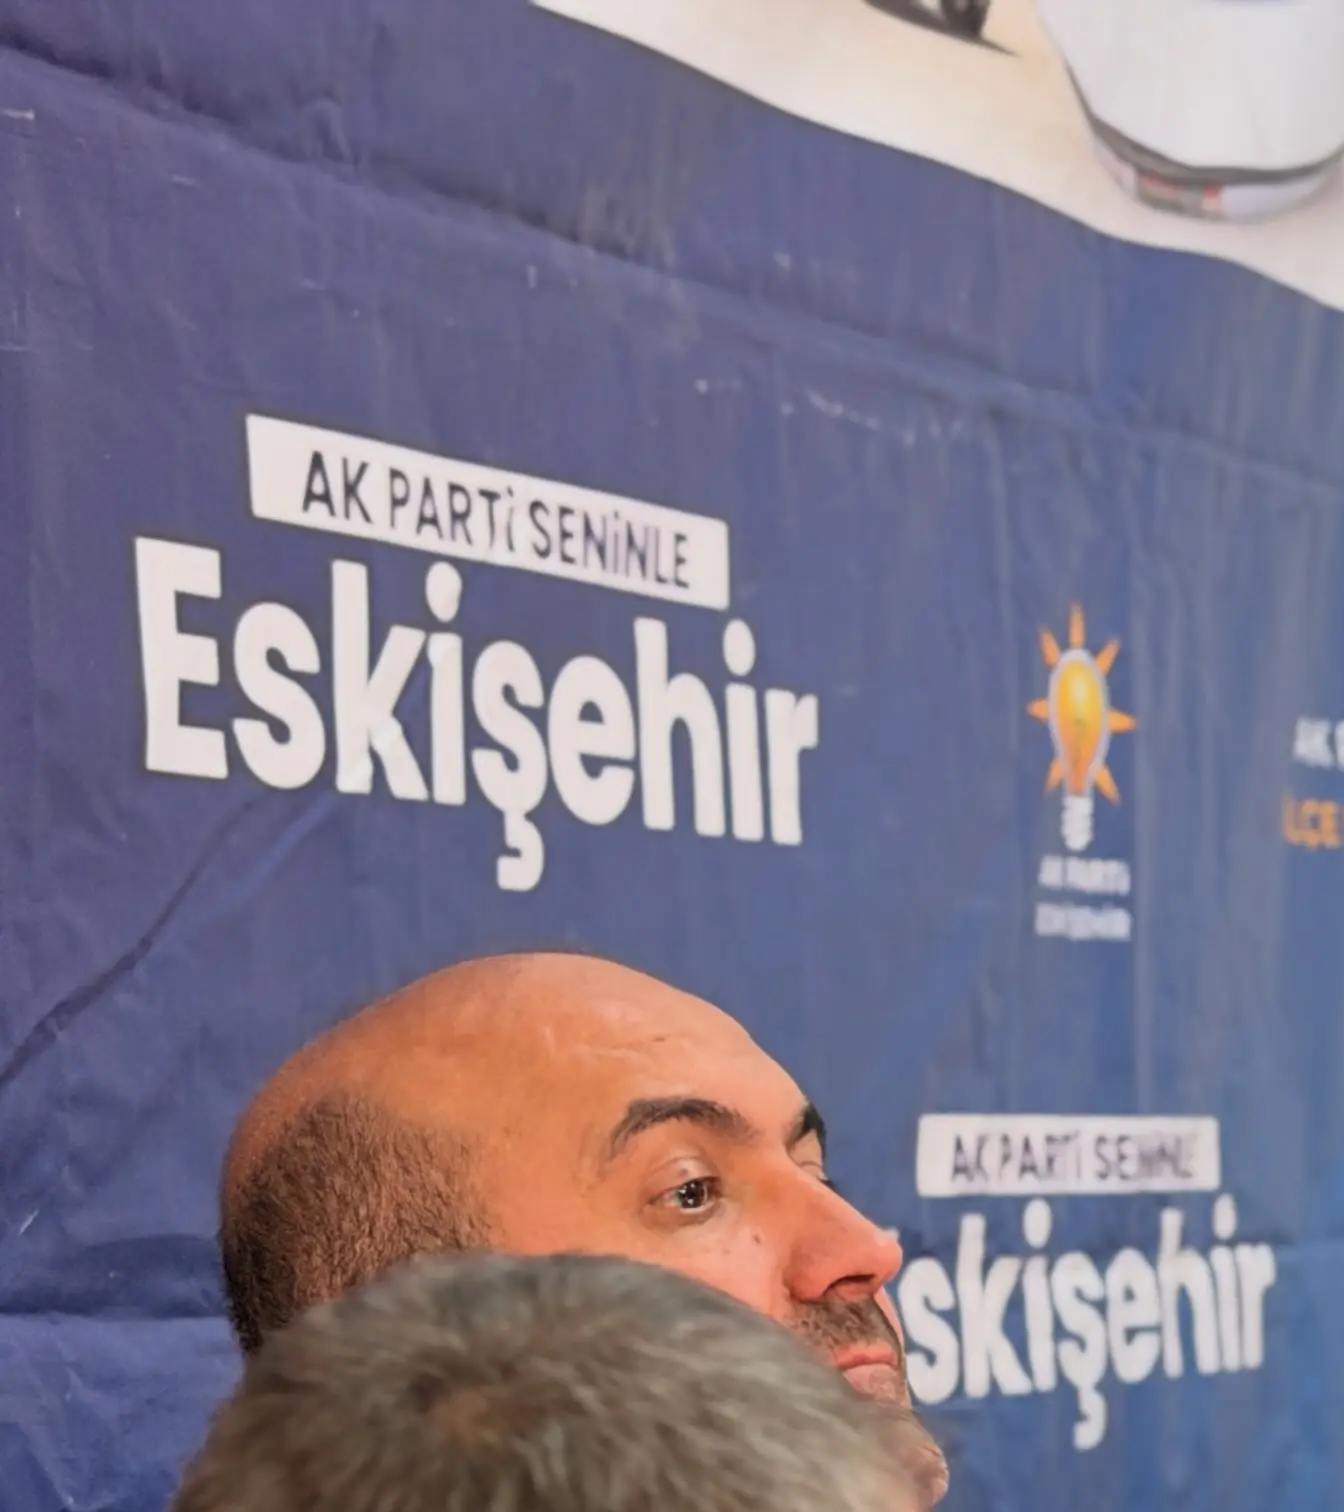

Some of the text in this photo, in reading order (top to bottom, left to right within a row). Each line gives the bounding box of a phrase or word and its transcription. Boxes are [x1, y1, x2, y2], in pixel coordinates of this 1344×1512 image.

[302, 450, 690, 591] AK PARTİ SENİNLE
[135, 536, 819, 892] Eskişehir
[951, 1132, 990, 1182] AK
[886, 1194, 1276, 1450] skişehir
